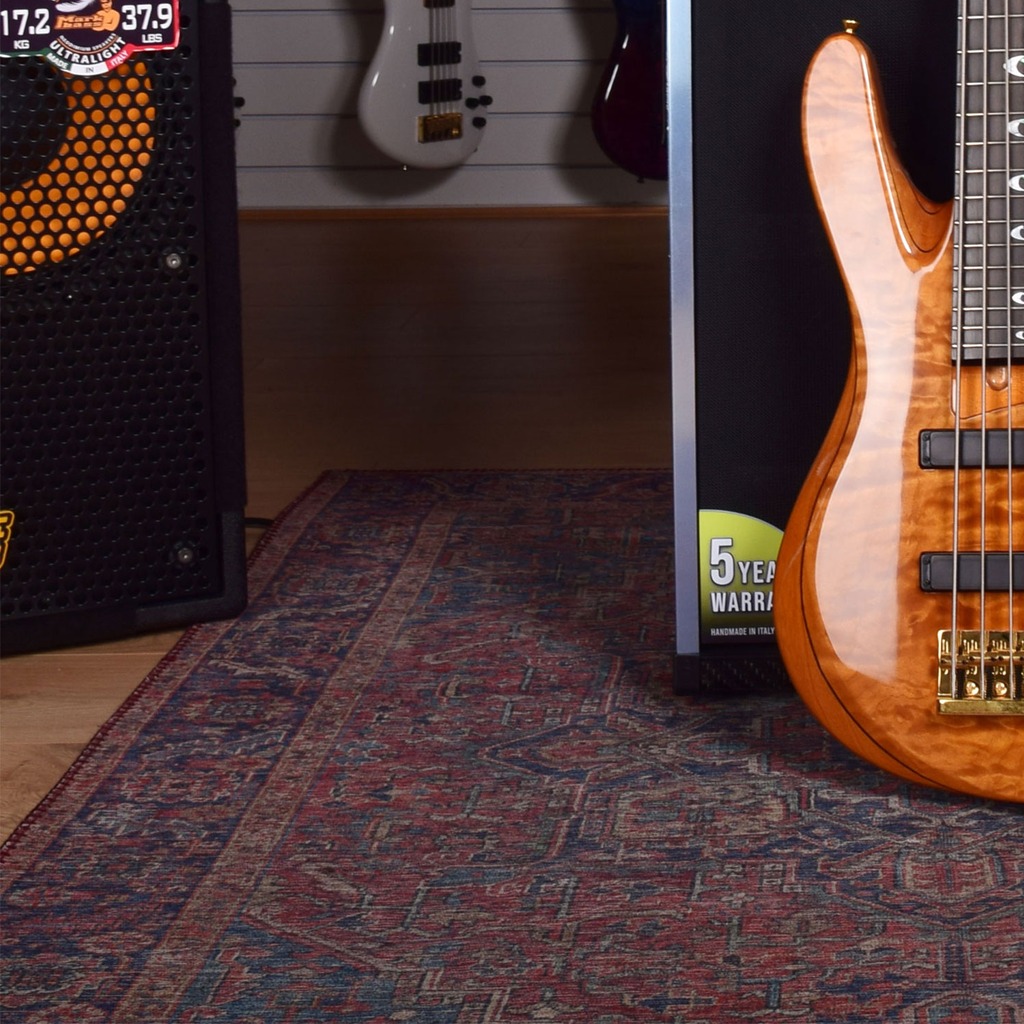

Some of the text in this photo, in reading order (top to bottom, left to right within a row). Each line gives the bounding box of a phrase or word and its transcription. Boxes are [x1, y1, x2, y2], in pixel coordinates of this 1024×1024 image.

[0, 8, 50, 36] 17.2
[121, 3, 173, 31] 37.9
[13, 40, 30, 50] KG
[141, 34, 163, 44] LBS
[49, 37, 126, 64] ULTRALIGHT
[110, 50, 129, 67] ITALY
[46, 53, 69, 69] MADE
[710, 538, 735, 586] 5
[710, 627, 775, 636] HANDMADE IN ITALY
